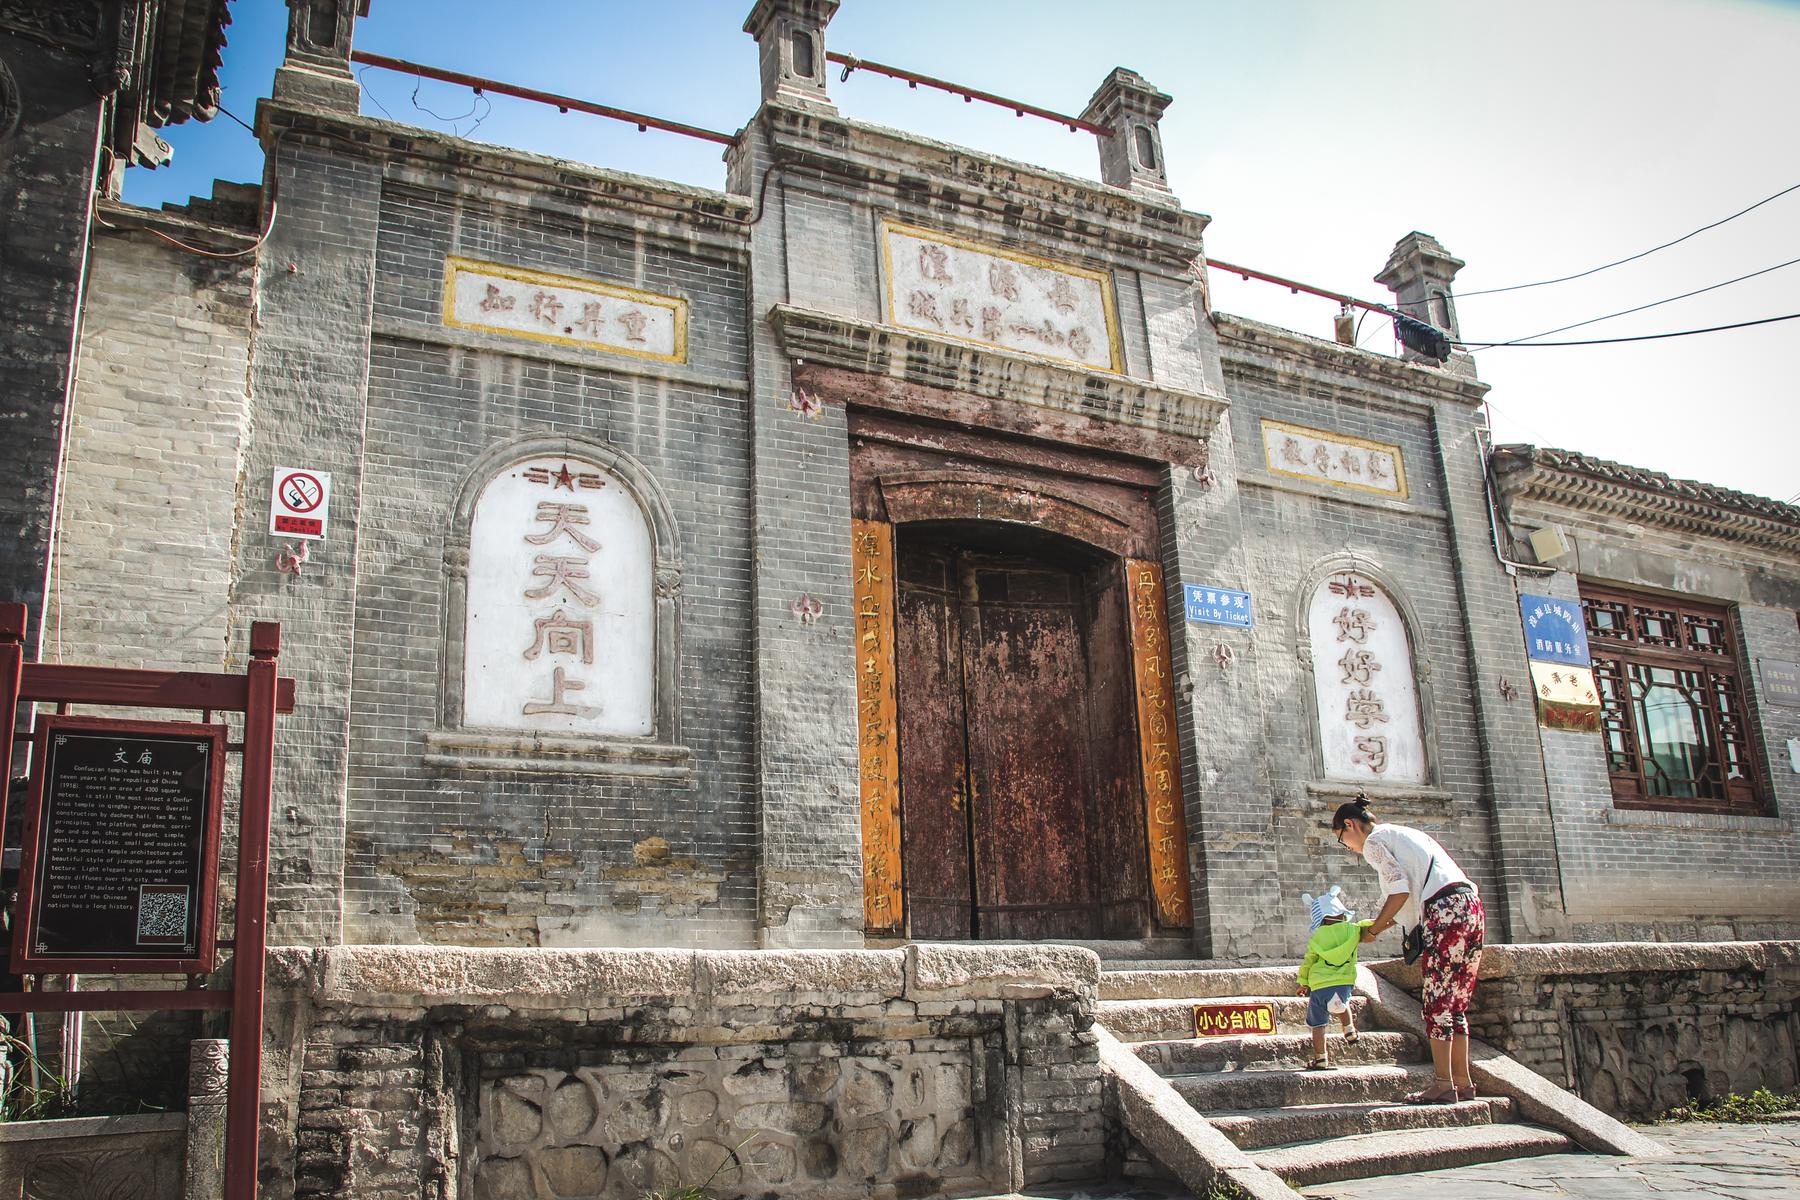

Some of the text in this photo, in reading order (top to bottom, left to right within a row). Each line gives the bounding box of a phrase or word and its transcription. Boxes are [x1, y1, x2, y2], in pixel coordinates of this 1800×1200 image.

[1192, 590, 1244, 608] 凭票参观
[522, 501, 603, 720] 天天向上
[1189, 605, 1249, 622] Visit By Ticket
[1332, 606, 1390, 774] 好好学习
[113, 747, 153, 765] 文庙
[1199, 1010, 1258, 1031] 小心台阶
